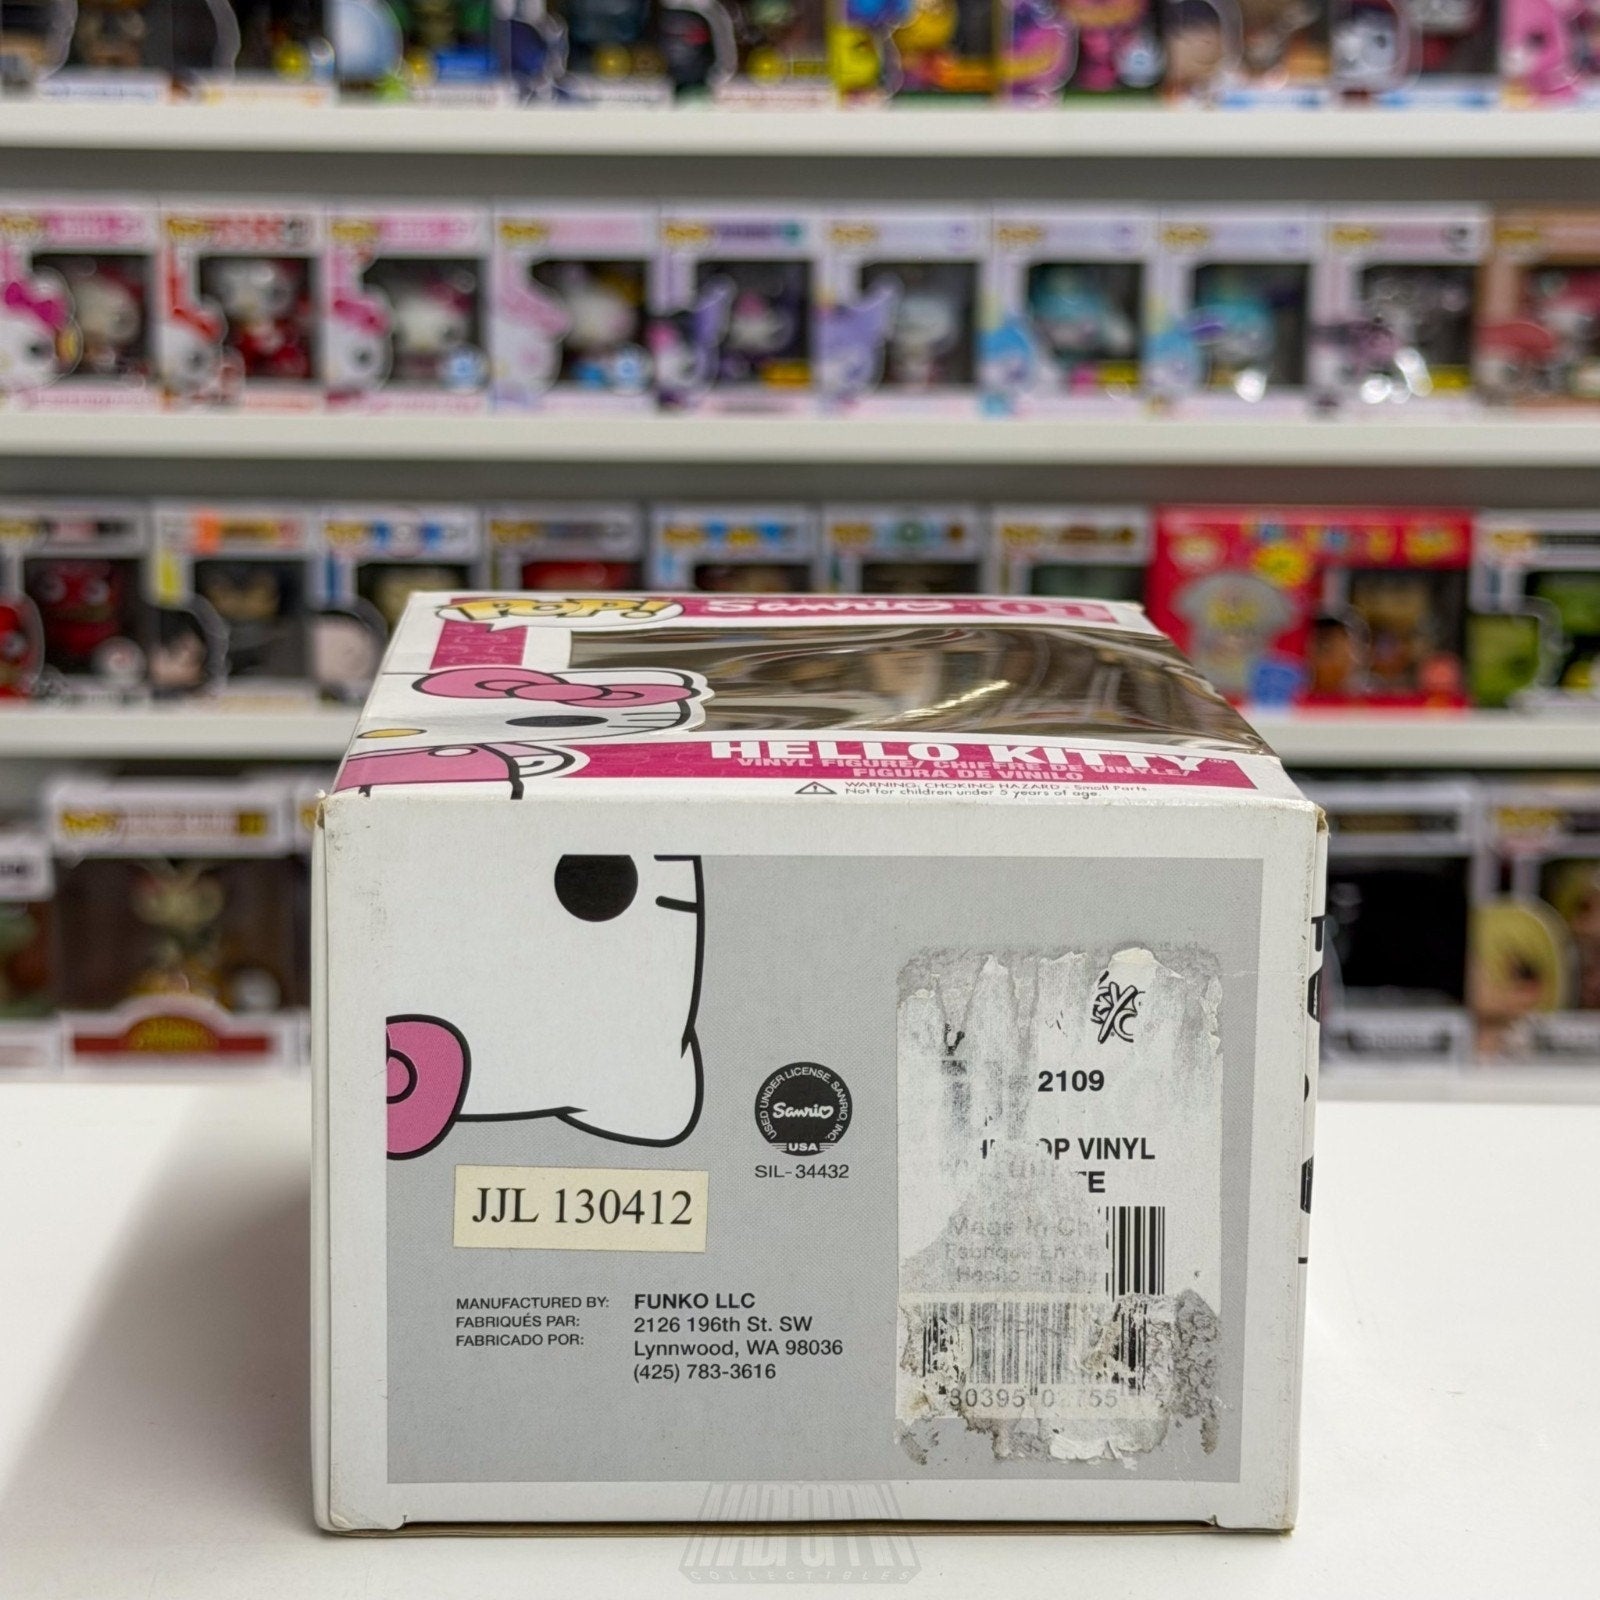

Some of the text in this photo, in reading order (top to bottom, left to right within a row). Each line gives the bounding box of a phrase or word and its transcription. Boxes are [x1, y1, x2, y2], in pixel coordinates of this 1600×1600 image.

[456, 598, 677, 620] POP!
[706, 599, 951, 613] Sanrio
[711, 741, 1206, 771] HELLO KITTY
[738, 757, 813, 767] VINYL
[821, 759, 924, 771] FIGURE/
[934, 761, 1047, 771] CHIFFRE
[1050, 763, 1084, 773] DE
[853, 768, 1084, 780] FIGURA DE VINILO
[900, 788, 950, 796] children
[1013, 790, 1050, 799] years
[1053, 789, 1068, 797] of
[925, 782, 994, 790] CHOKING
[1037, 1069, 1105, 1092] 2109
[760, 1074, 786, 1109] UNDER
[772, 1102, 835, 1119] Sanrio
[759, 1110, 778, 1140] USED
[788, 1142, 819, 1152] USA
[1077, 1136, 1156, 1160] VINYL
[472, 1187, 693, 1225] JJL 130412
[456, 1296, 609, 1310] MANUFACTURED BY:
[634, 1292, 756, 1309] FUNKO LLC
[456, 1312, 580, 1328] FABRIQUÉS PAR:
[634, 1316, 813, 1333] 2126 196th St. SW
[456, 1333, 584, 1346] FABRICADO POR:
[634, 1340, 843, 1360] Lynnwood, WA 98036
[633, 1363, 777, 1383] (425) 783-3616
